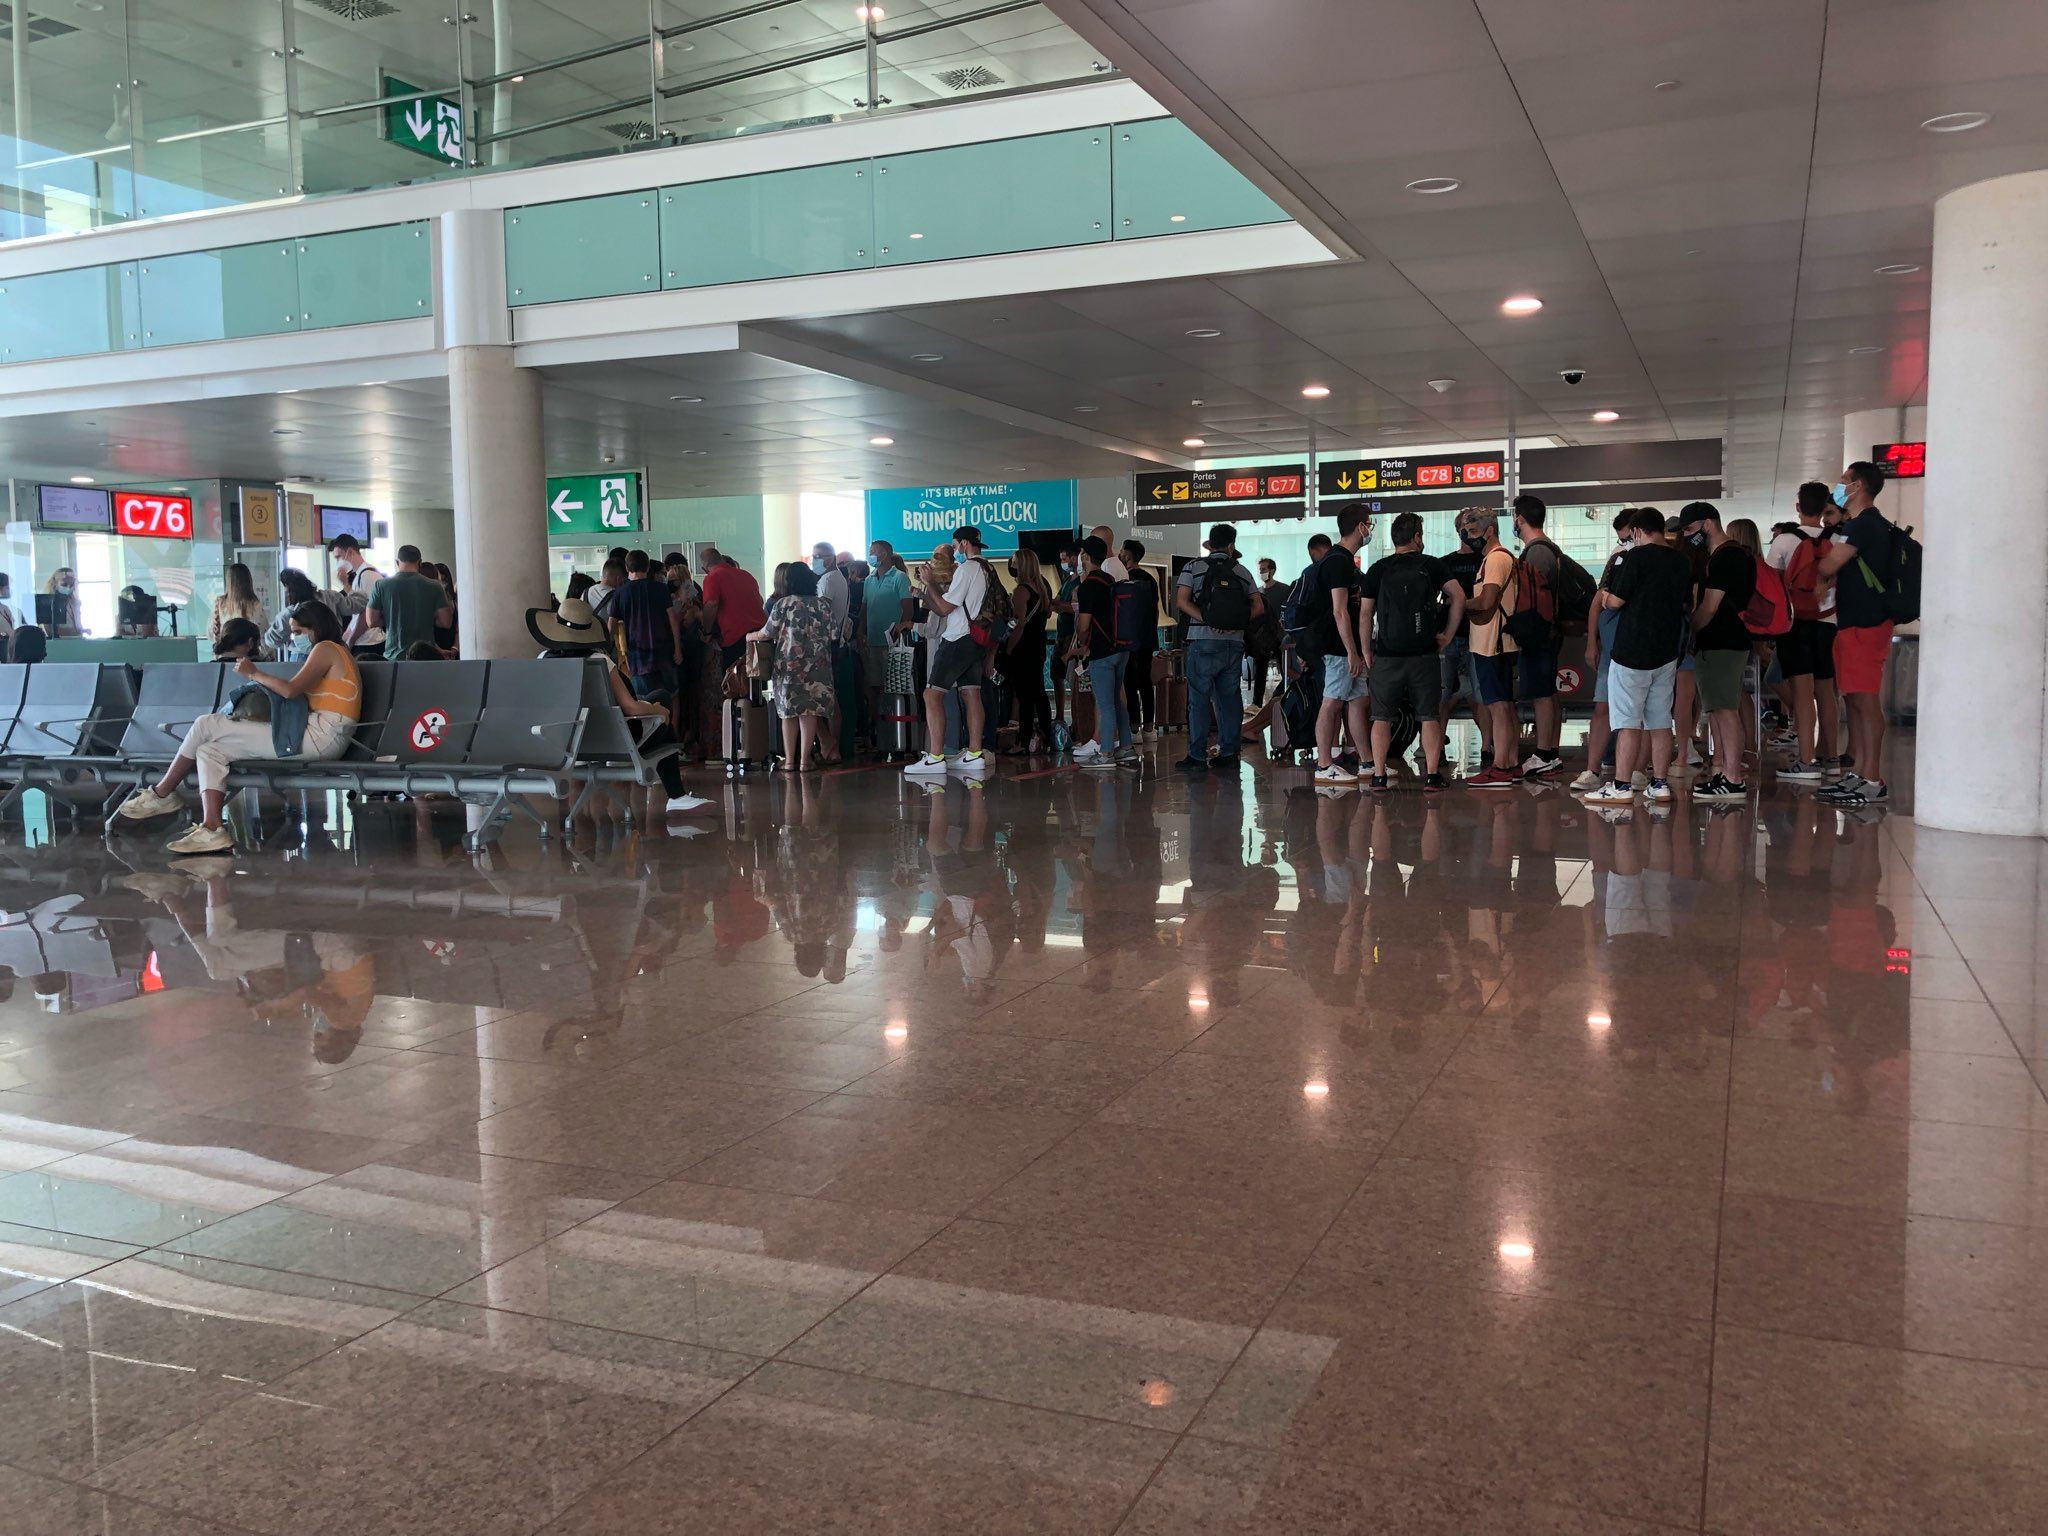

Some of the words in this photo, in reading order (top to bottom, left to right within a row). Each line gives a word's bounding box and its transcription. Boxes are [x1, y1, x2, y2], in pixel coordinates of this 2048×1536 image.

[1381, 460, 1407, 469] Portes
[1193, 473, 1217, 481] Portes
[1381, 470, 1401, 478] Gates
[1420, 469, 1448, 483] C78
[1466, 466, 1495, 480] C86
[1193, 482, 1211, 490] Gates
[1228, 481, 1254, 494] C76
[1271, 478, 1297, 492] C77
[1381, 479, 1412, 488] Puertas
[925, 489, 941, 498] IT'S
[944, 486, 977, 497] BREAK
[979, 485, 1007, 496] TIME!
[1193, 490, 1221, 499] Puertas
[1260, 488, 1265, 496] y
[959, 497, 972, 505] IT'S
[124, 499, 186, 533] C76
[257, 509, 263, 520] 3
[902, 507, 966, 532] BRUNCH
[970, 501, 1037, 525] O'CLOCK!
